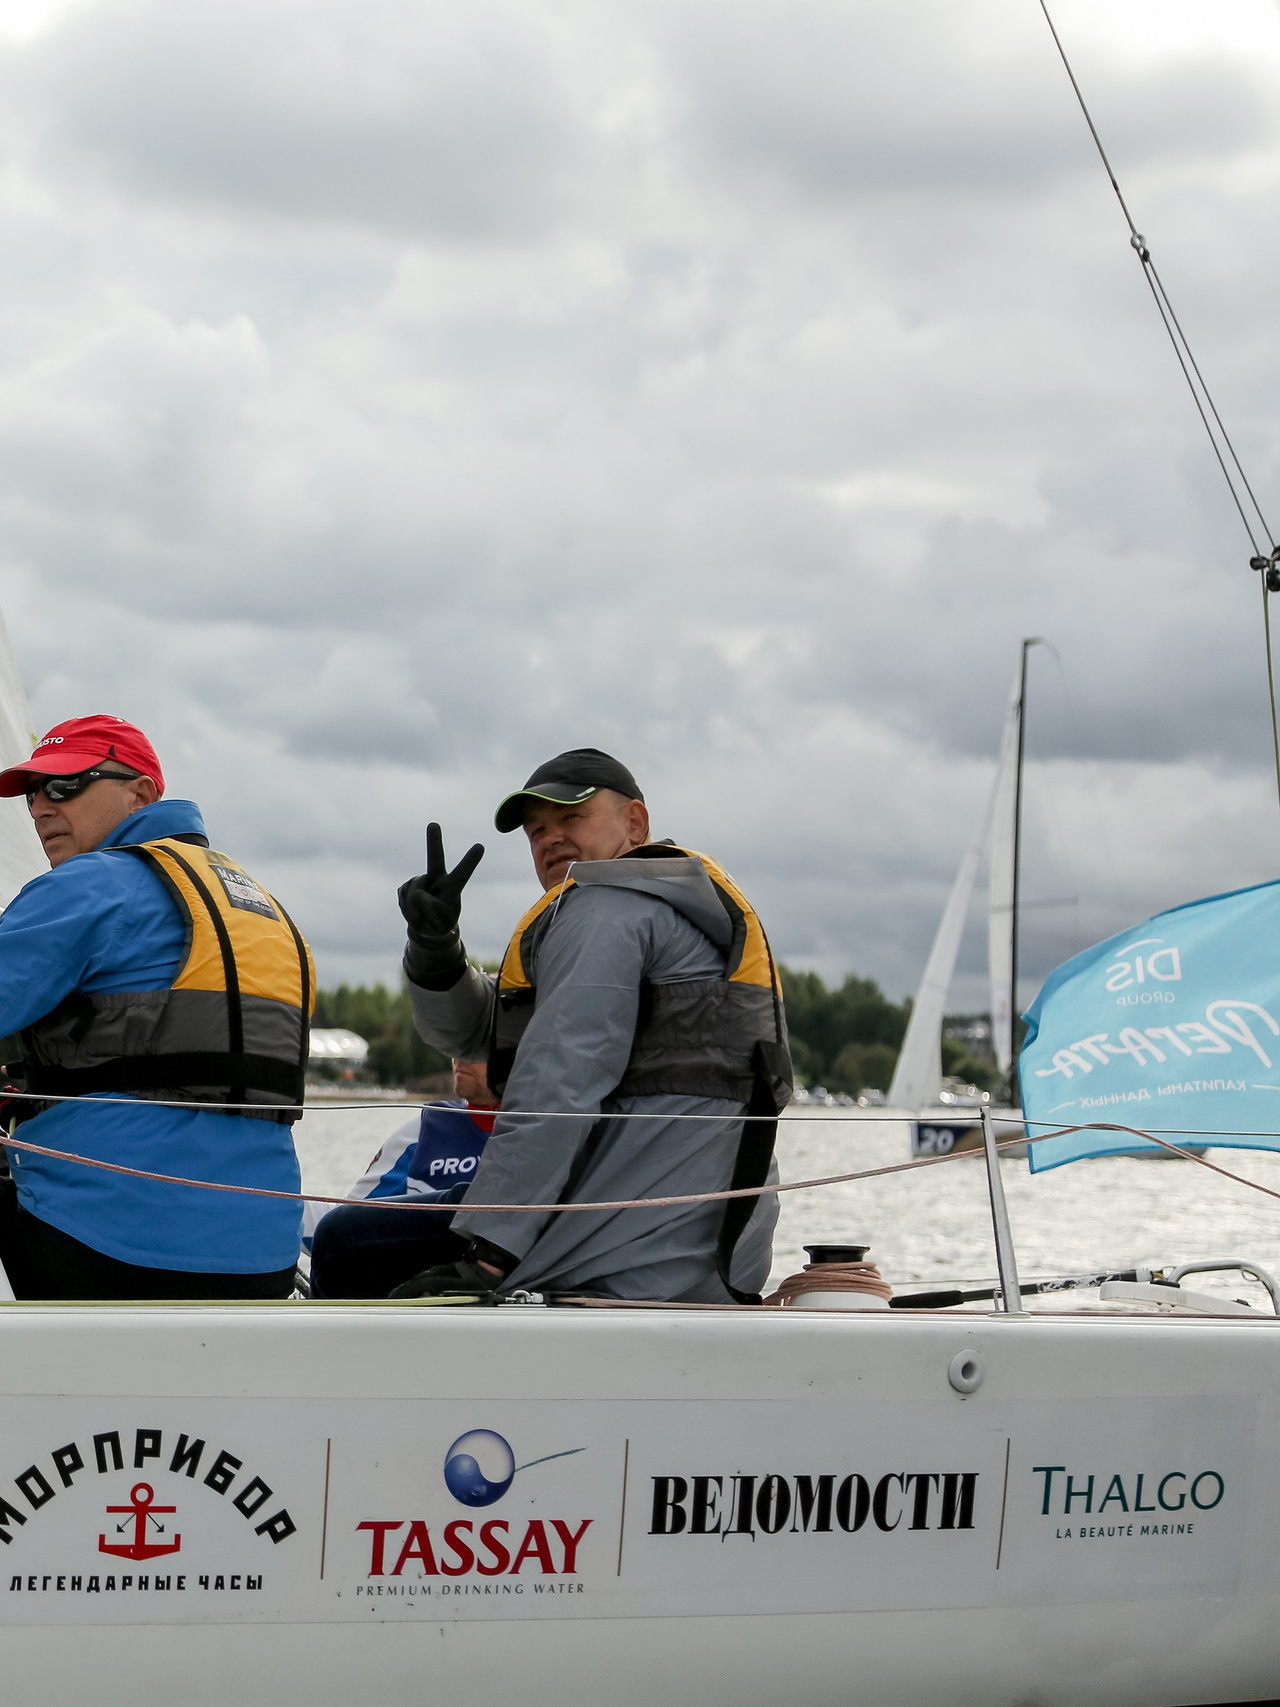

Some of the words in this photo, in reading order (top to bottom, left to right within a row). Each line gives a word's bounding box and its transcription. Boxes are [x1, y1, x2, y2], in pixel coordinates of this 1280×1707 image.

[429, 1156, 482, 1176] PRO
[1032, 1466, 1225, 1515] THALGO
[648, 1472, 979, 1543] ВЕДОМОСТИ
[1056, 1527, 1072, 1539] LA
[1079, 1524, 1134, 1538] BEAUTÉ
[1140, 1523, 1195, 1536] MARINE
[356, 1520, 594, 1576] TASSAY
[10, 1576, 186, 1593] ЛЕГЕНДАРНЫЕ
[199, 1575, 263, 1590] ЧАСЫ
[357, 1586, 431, 1596] PREMIUM
[442, 1584, 524, 1595] DRINKING
[534, 1583, 585, 1594] WATER
